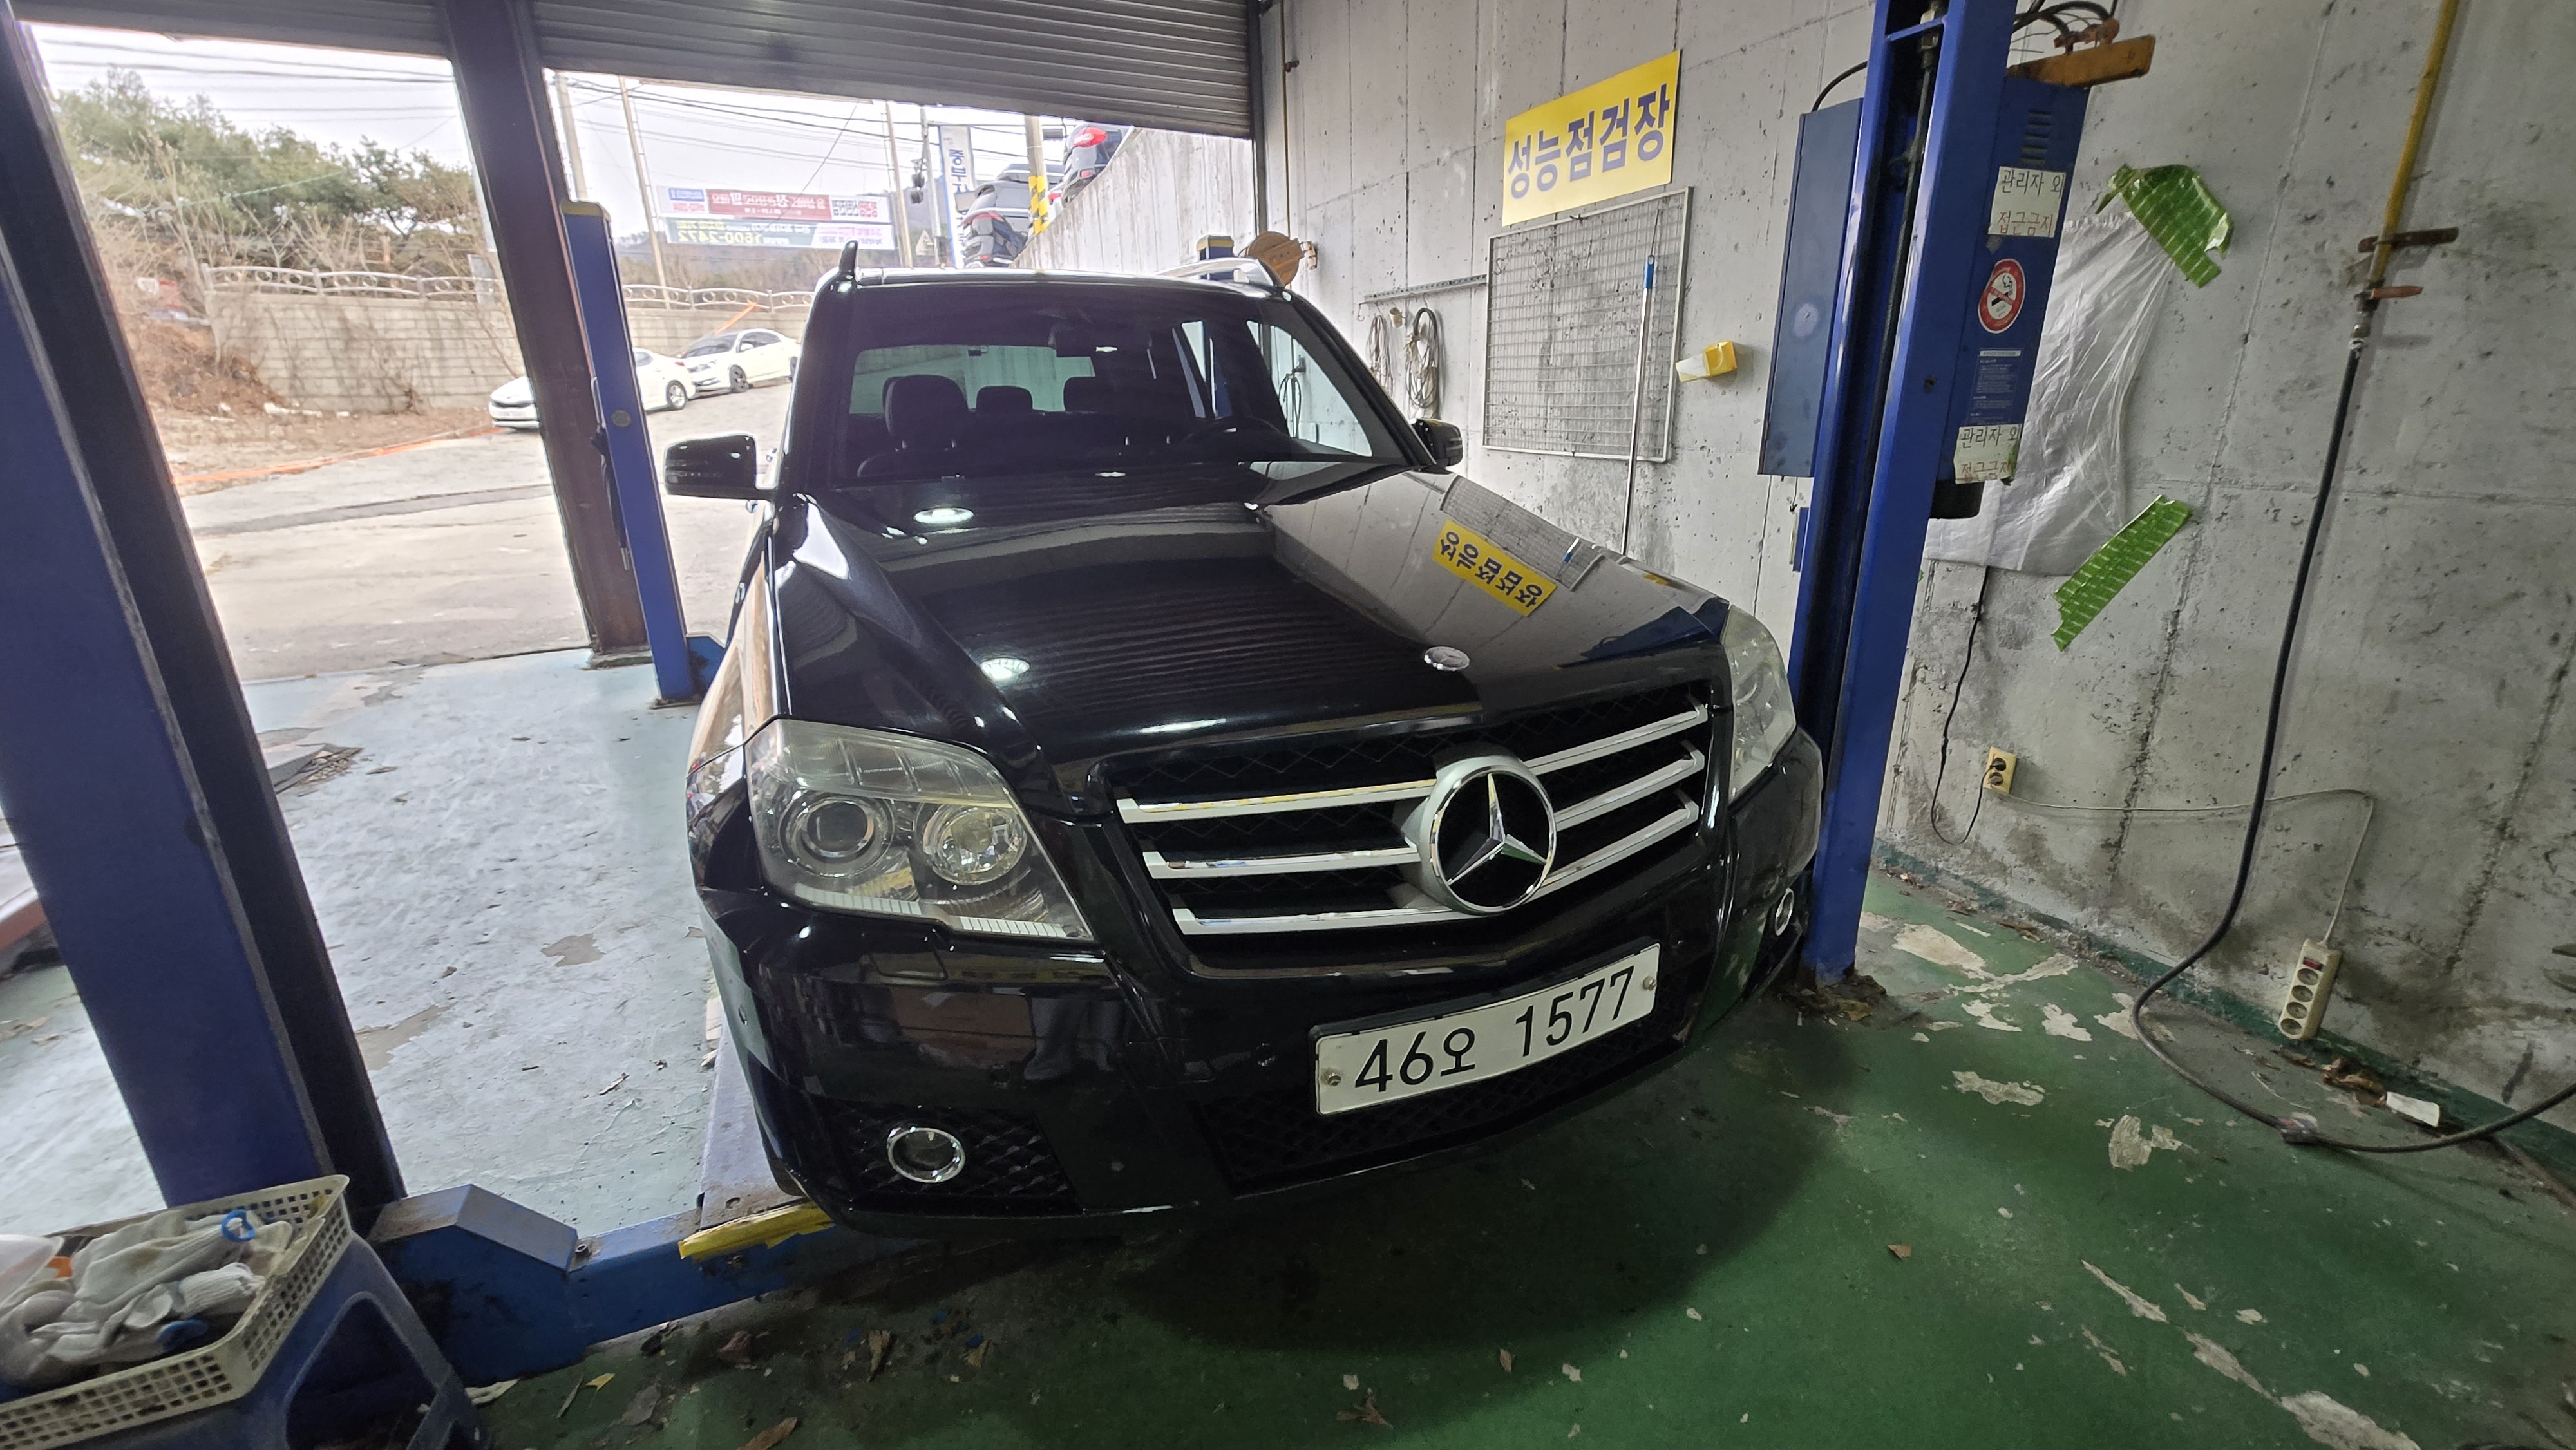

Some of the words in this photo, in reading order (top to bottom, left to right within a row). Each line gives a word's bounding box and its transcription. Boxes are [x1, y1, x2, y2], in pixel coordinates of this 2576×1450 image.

[1508, 83, 1670, 200] 성능점검장
[2001, 169, 2044, 196] 관리자
[2050, 174, 2065, 199] 외
[1998, 211, 2054, 237] 접근금지
[1960, 426, 2002, 449] 관리자
[1355, 1028, 1475, 1092] 46오
[1515, 965, 1635, 1057] 1577
